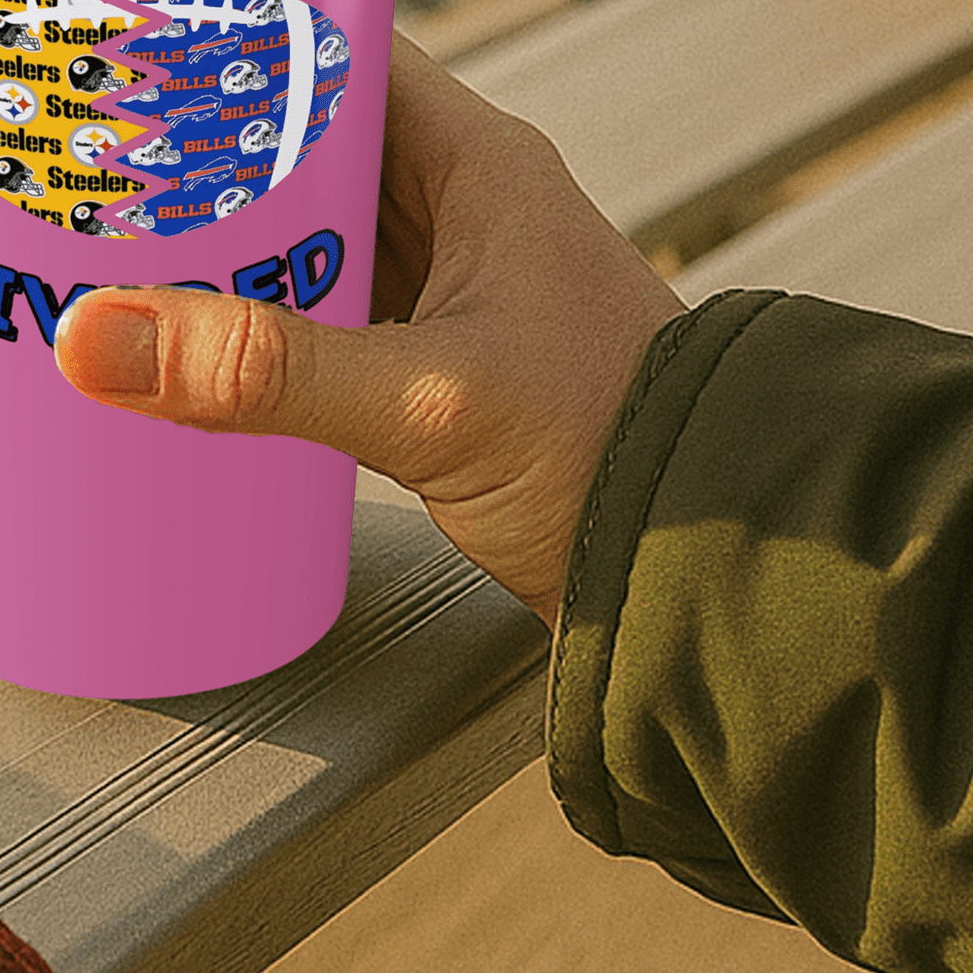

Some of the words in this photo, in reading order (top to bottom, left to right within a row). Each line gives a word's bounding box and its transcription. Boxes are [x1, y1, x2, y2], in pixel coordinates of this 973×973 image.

[240, 32, 290, 55] BILLS
[161, 74, 218, 92] BILLS
[315, 71, 349, 97] BILLS
[220, 100, 271, 122] BILLS
[183, 135, 237, 154] BILLS
[157, 202, 213, 220] BILLS
